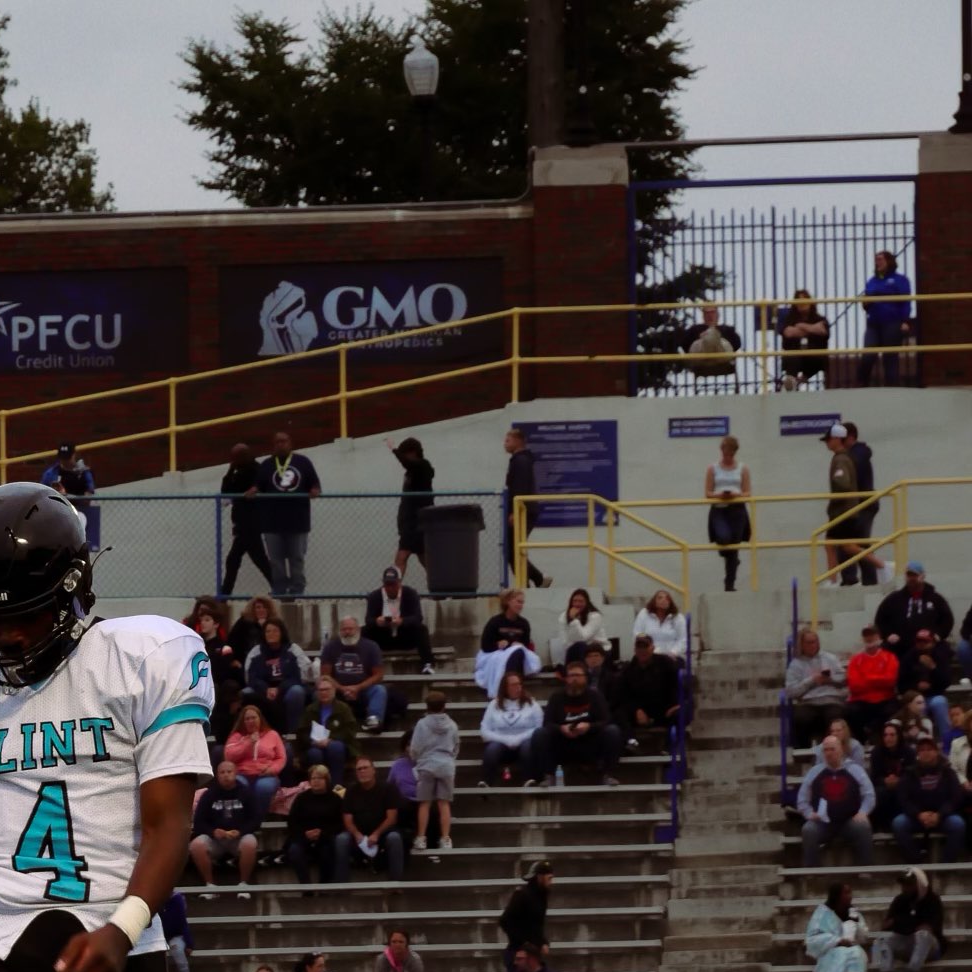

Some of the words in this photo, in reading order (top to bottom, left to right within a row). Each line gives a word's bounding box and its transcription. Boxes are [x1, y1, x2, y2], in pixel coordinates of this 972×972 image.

[322, 283, 468, 330] GMO
[11, 313, 122, 352] PFCU
[15, 355, 64, 369] Credit
[70, 354, 115, 368] Union
[12, 780, 90, 903] 4
